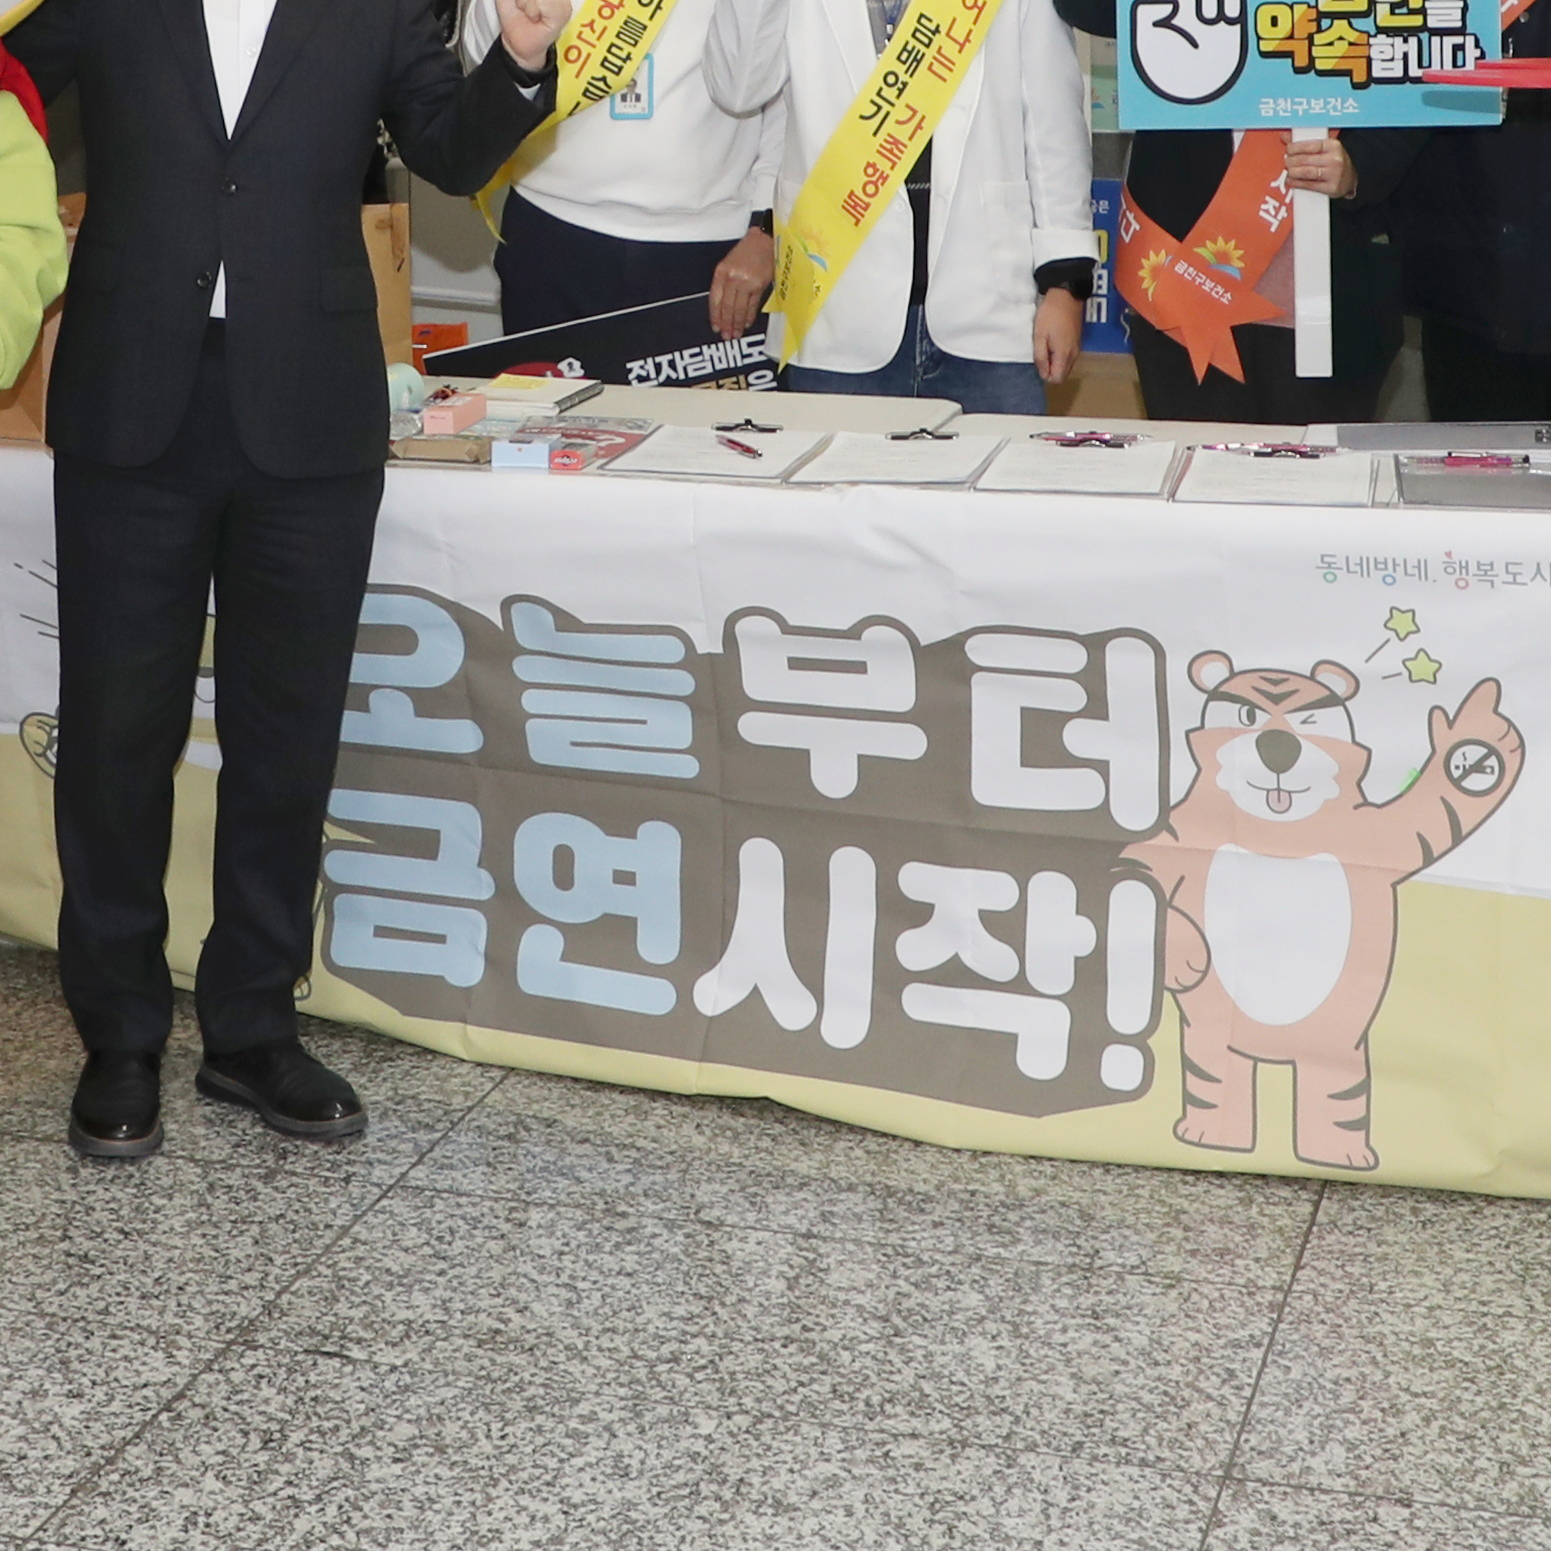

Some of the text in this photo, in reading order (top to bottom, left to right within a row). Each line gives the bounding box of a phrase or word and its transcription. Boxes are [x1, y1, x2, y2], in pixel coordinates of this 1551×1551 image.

[859, 12, 942, 137] 담배연기
[1255, 3, 1485, 88] 약속합니다
[1259, 97, 1359, 116] 금천구보건소
[840, 103, 927, 227] 가족행복
[1173, 259, 1233, 305] 금천구보건소
[626, 333, 769, 388] 전자담배도
[1316, 553, 1437, 586] 동네방네.
[341, 592, 1164, 833] 오늘부터
[324, 788, 1156, 1091] 금연 시작!
